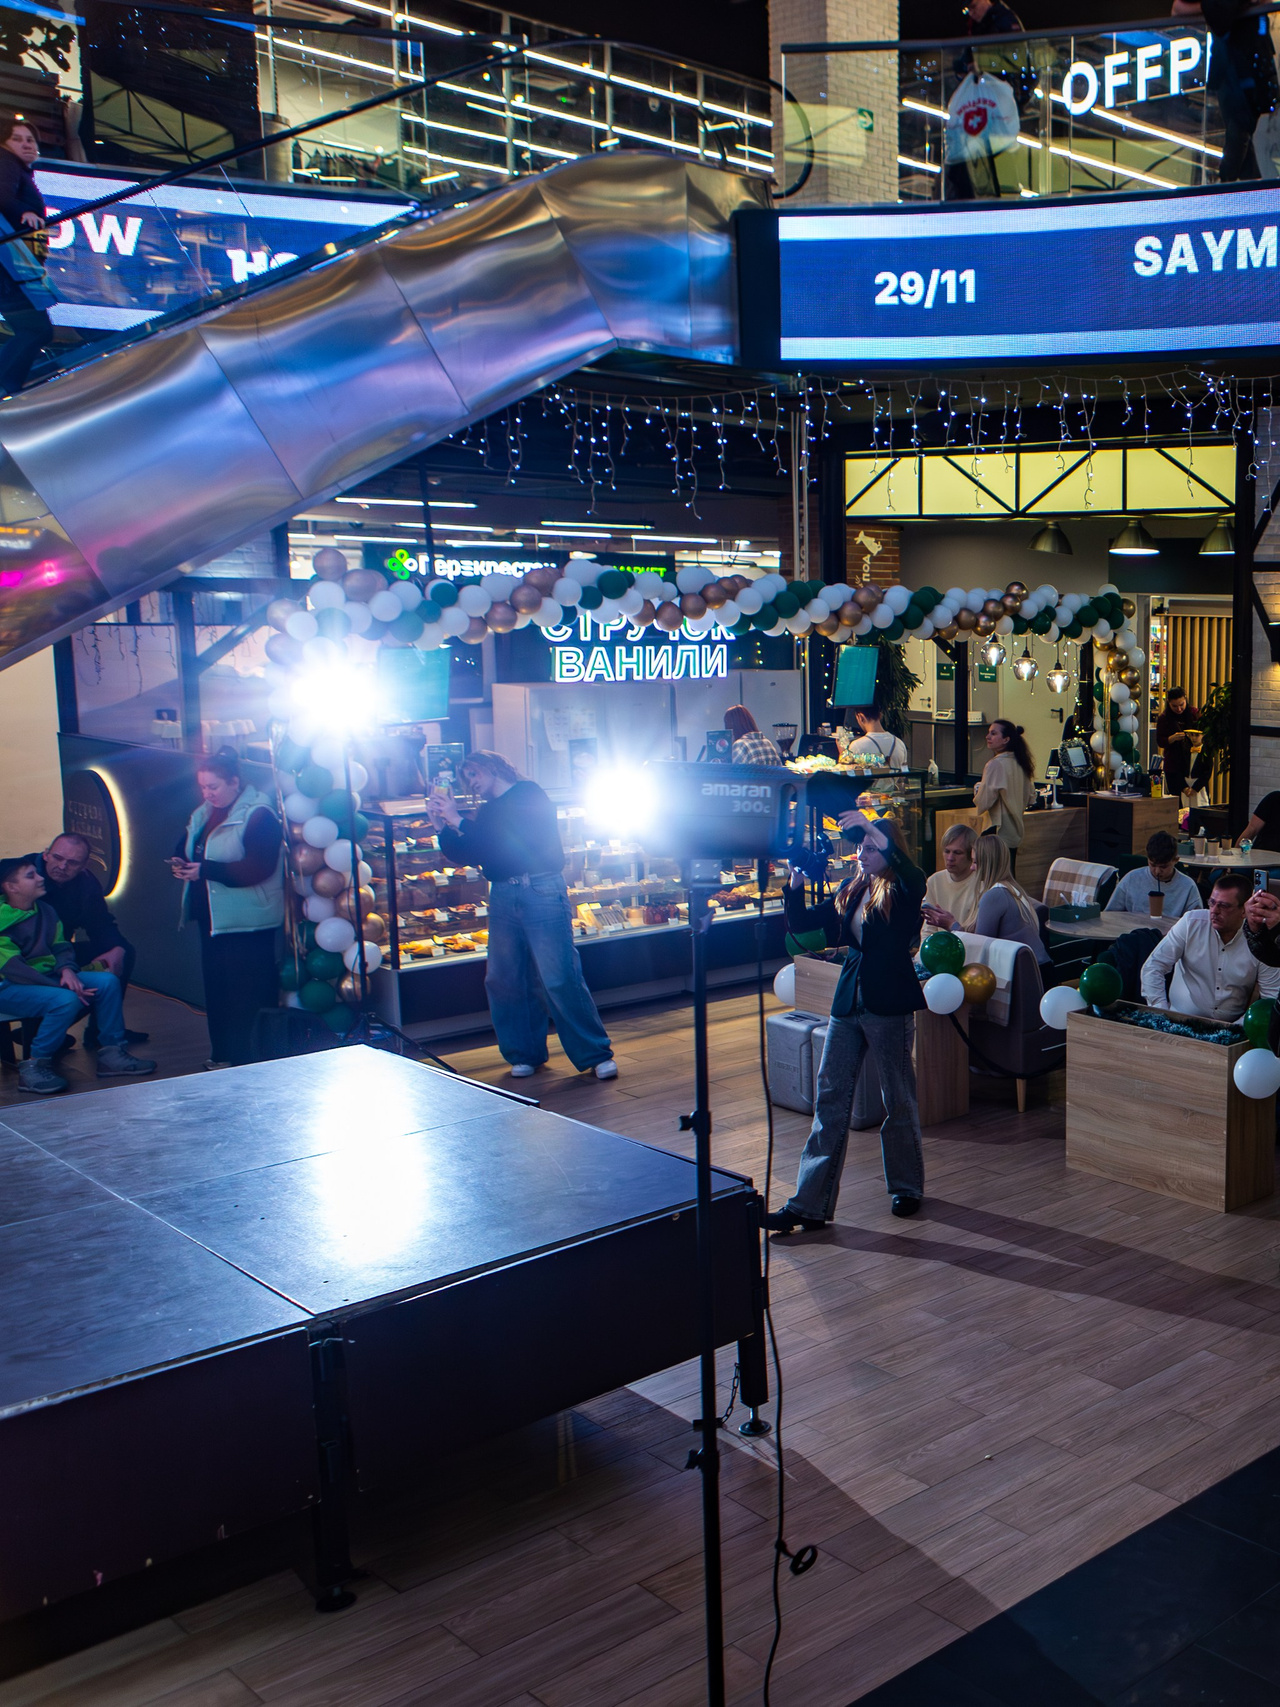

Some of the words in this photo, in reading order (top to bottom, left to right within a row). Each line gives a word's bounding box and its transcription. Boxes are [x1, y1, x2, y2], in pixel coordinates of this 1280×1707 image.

[1062, 31, 1213, 116] OFFP
[874, 268, 976, 309] 29/11
[554, 643, 729, 684] ВАНИЛИ
[701, 783, 772, 798] amaran
[732, 800, 771, 814] 300c
